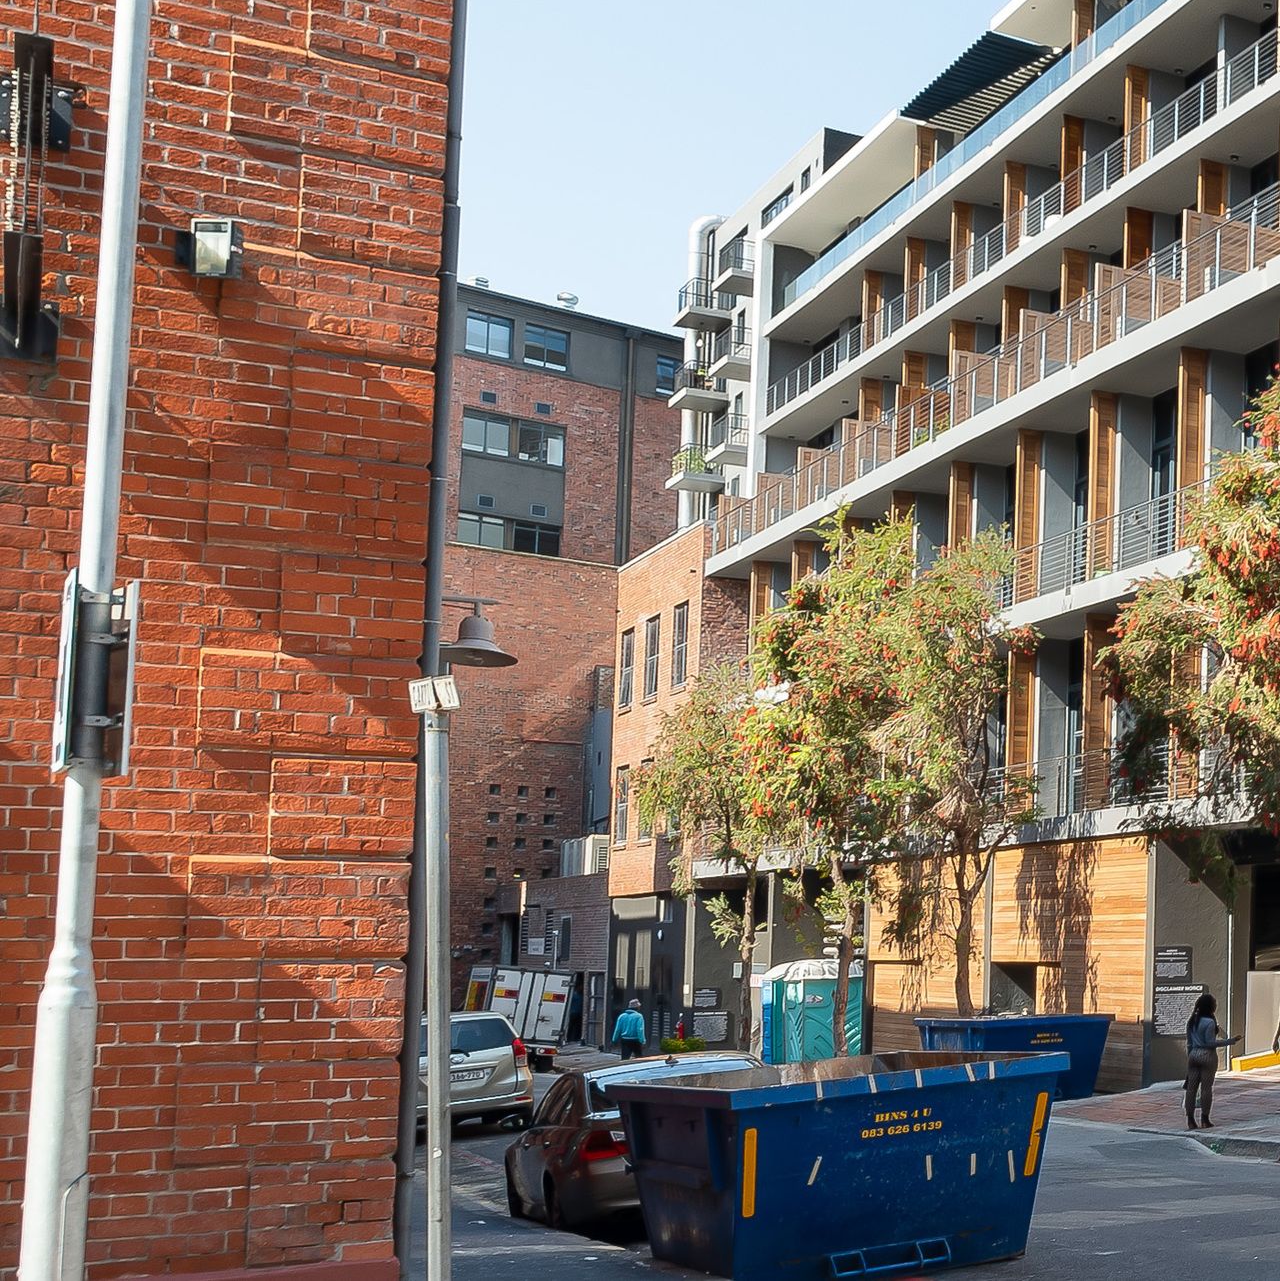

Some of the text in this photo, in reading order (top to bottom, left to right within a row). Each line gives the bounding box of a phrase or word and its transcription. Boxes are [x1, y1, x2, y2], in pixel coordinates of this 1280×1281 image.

[875, 1107, 932, 1123] BINS 4 U
[861, 1120, 943, 1139] 083 626 6139
